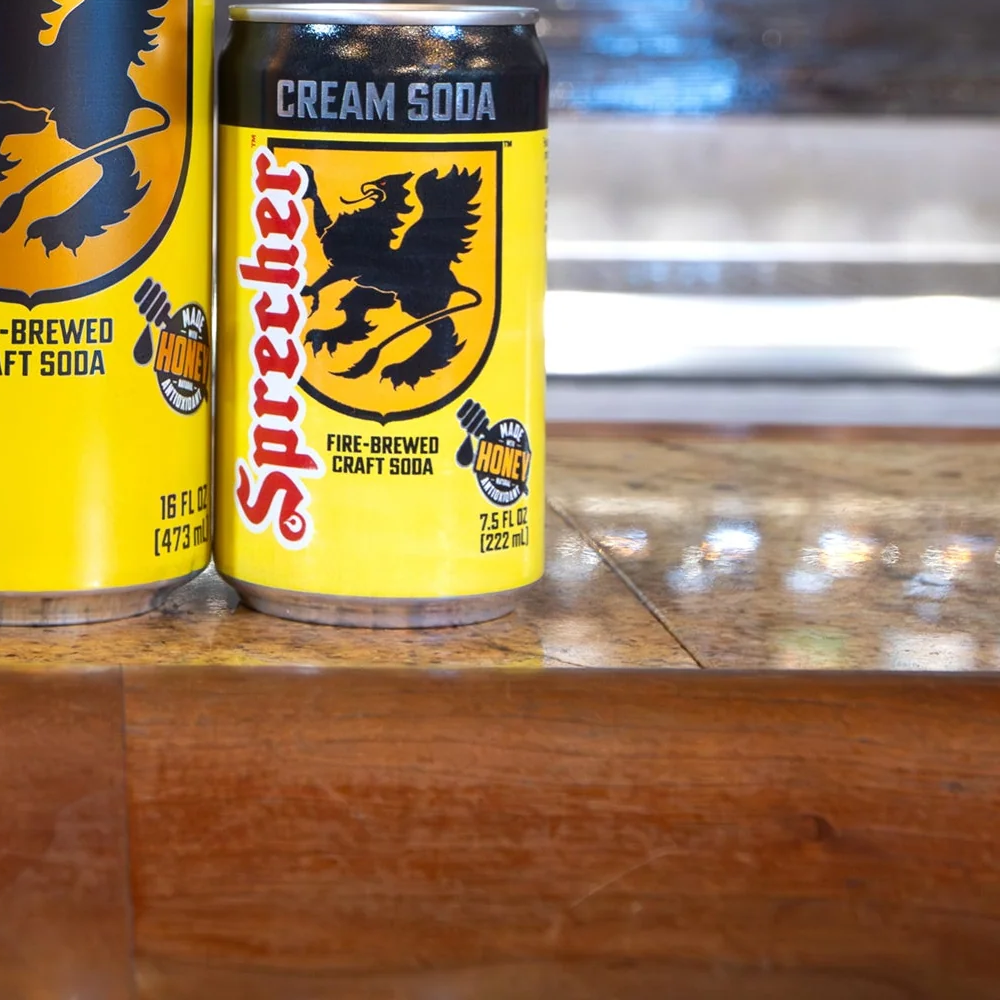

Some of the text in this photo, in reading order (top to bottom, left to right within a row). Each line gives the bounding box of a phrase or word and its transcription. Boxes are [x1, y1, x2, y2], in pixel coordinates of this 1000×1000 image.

[277, 79, 496, 121] CREAM SODA
[182, 306, 205, 332] MADE
[236, 150, 321, 545] Sprecher
[40, 350, 105, 377] SODA
[326, 434, 439, 454] FIRE-BREWED
[500, 422, 524, 442] MADE
[332, 456, 433, 475] CRAFT SODA
[476, 440, 531, 482] HONEY
[161, 494, 176, 520] 16
[181, 490, 194, 516] FL
[480, 507, 528, 531] 7.5 FL OZ
